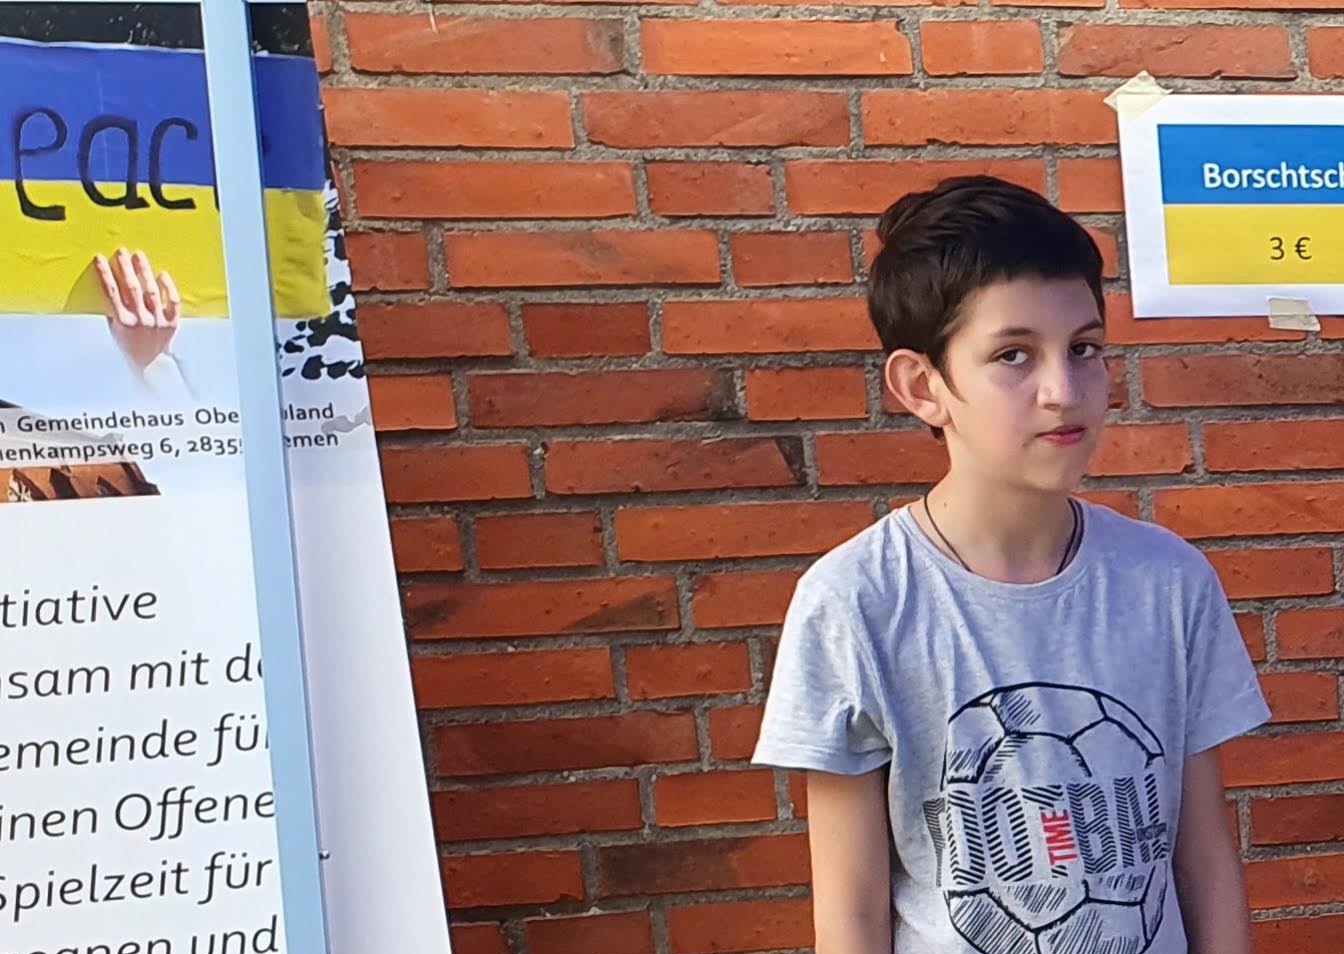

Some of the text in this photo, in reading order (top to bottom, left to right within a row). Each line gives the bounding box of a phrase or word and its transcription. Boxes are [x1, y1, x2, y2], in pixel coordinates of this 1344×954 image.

[14, 106, 219, 220] eac
[1268, 236, 1312, 261] 3 €
[17, 407, 184, 433] Gemeindehaus
[160, 438, 179, 457] 6,
[187, 436, 243, 456] 2835
[130, 650, 209, 690] mit
[225, 642, 263, 682] d
[206, 713, 269, 766] fü
[115, 785, 275, 841] Offene
[1040, 808, 1078, 866] TIME
[197, 851, 273, 904] für
